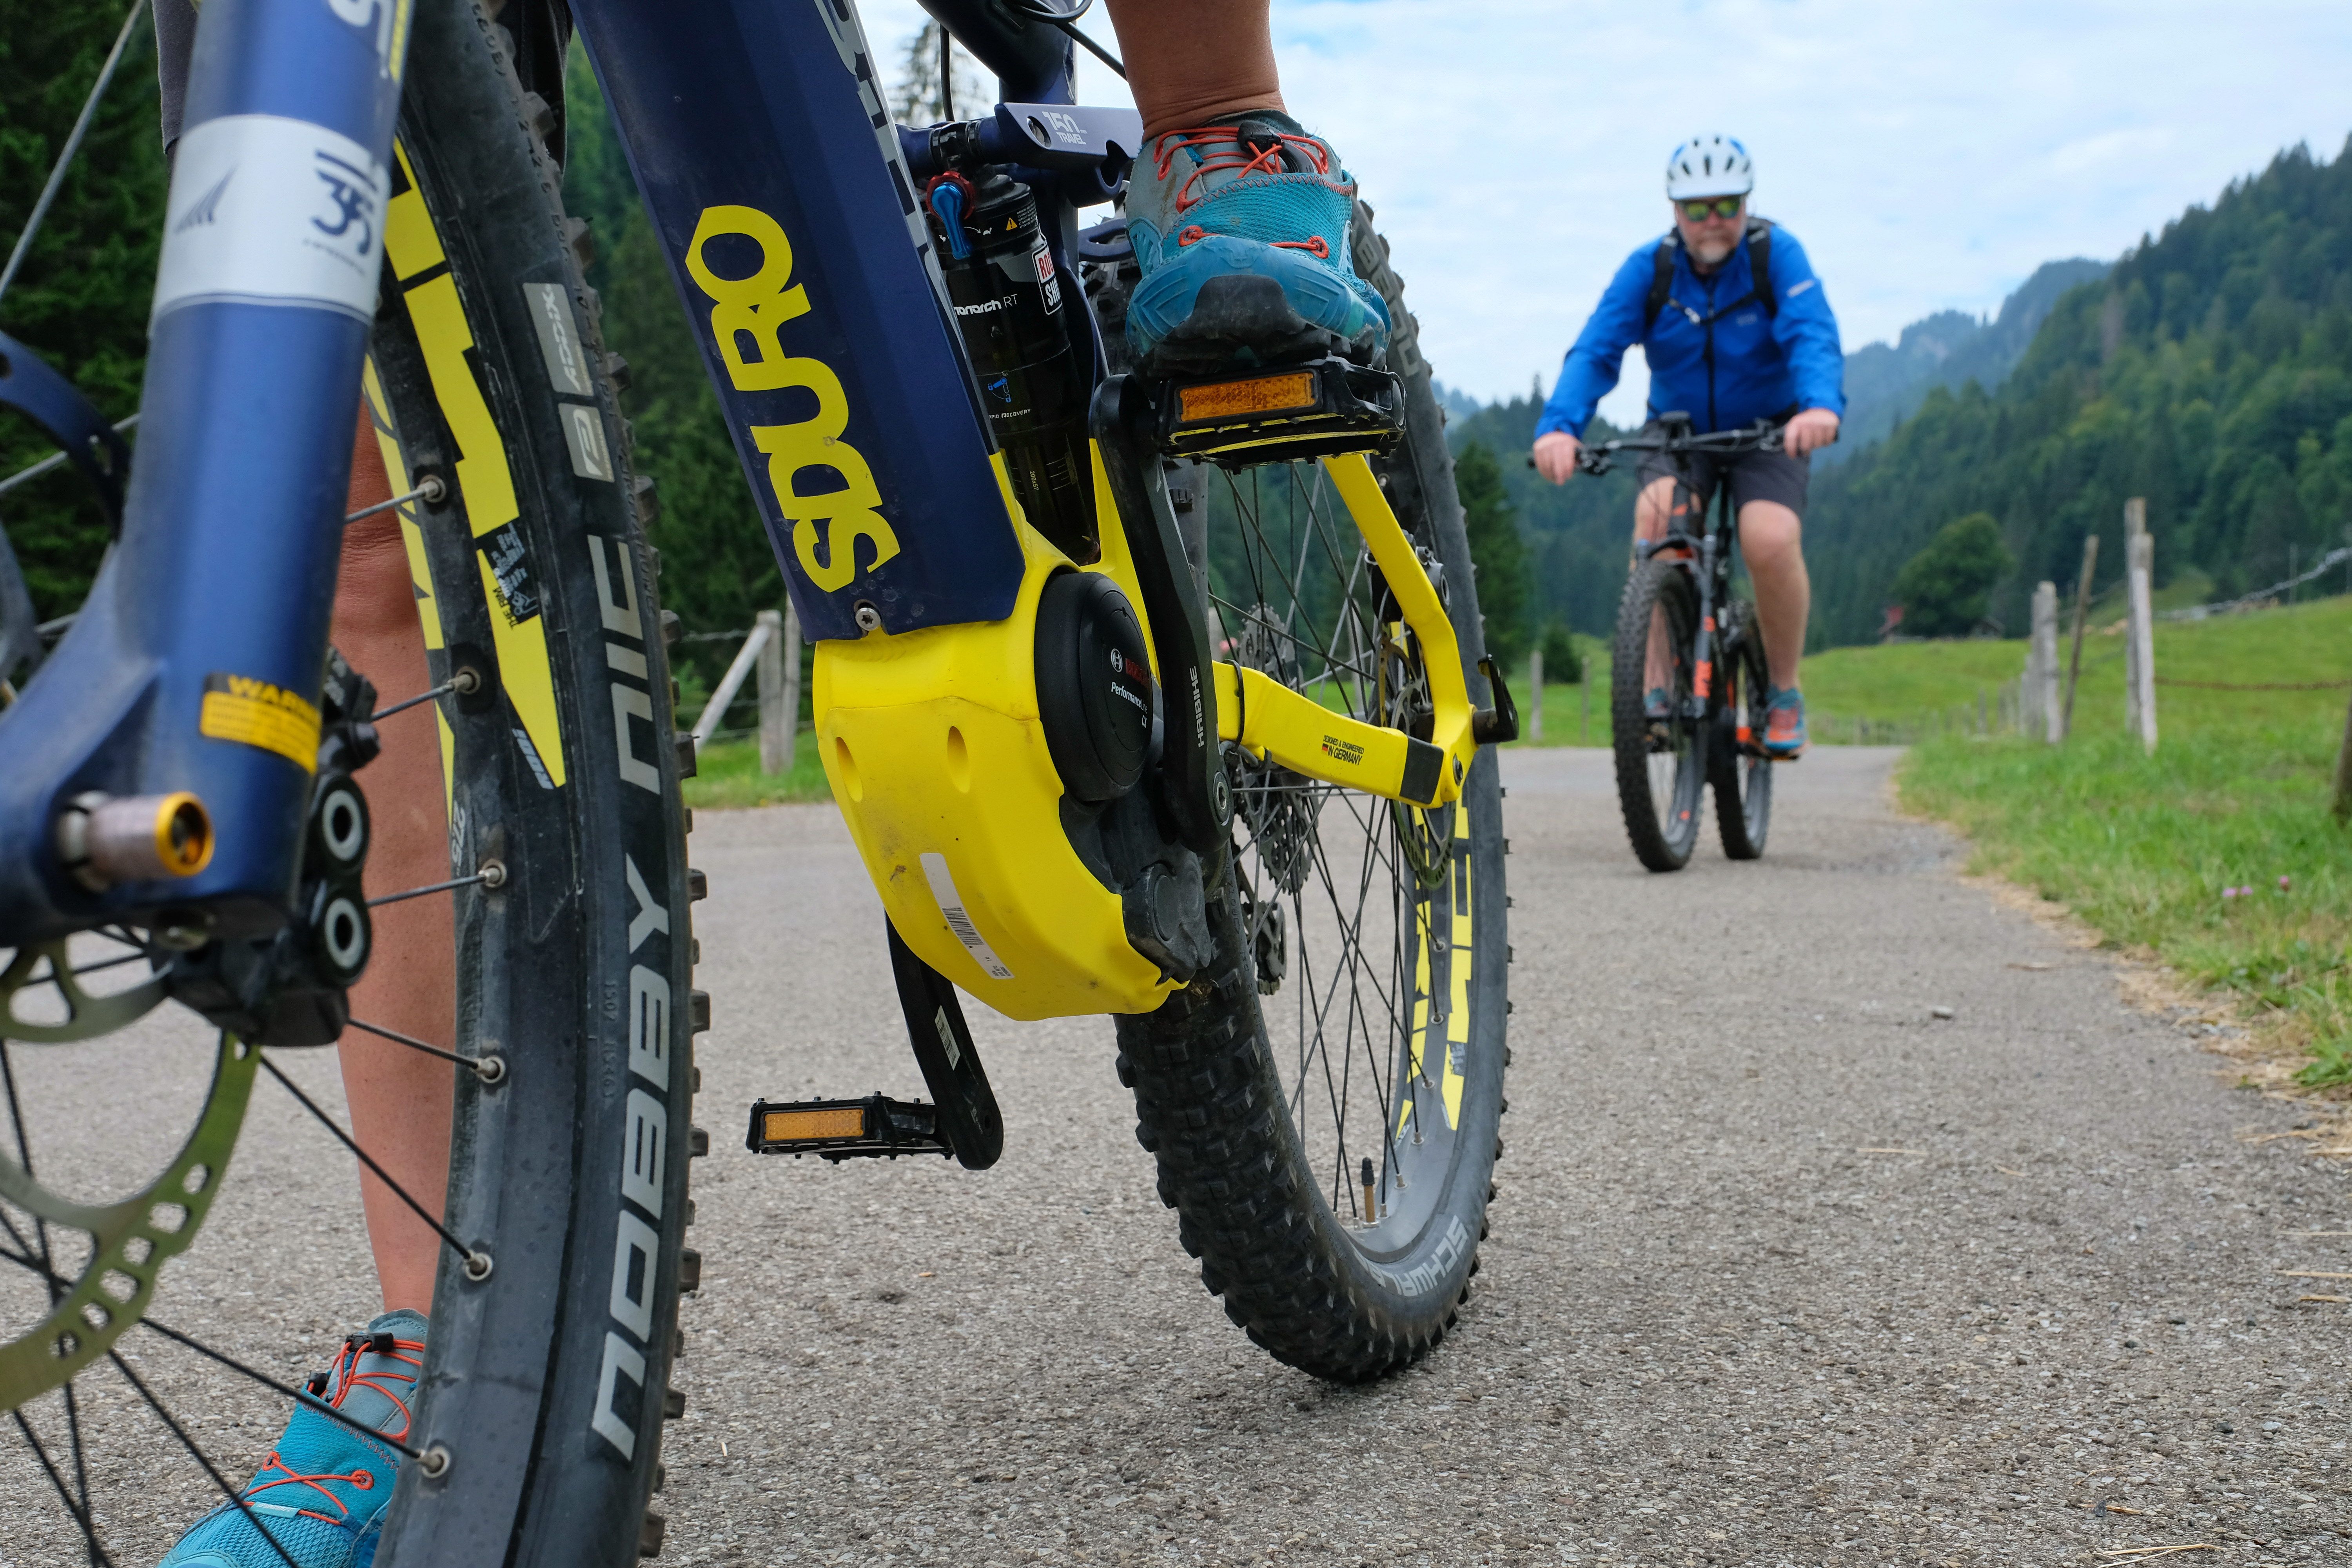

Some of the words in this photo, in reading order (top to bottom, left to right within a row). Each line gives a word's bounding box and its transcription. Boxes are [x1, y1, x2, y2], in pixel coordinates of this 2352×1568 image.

[1056, 132, 1086, 145] TRAVEL
[1003, 294, 1017, 308] RT
[686, 205, 901, 592] SDURO
[1001, 408, 1031, 418] RECOVERY
[1029, 470, 1039, 490] 200x57
[587, 534, 661, 795] NIC
[1111, 681, 1141, 708] Performance
[1189, 666, 1204, 748] HAIBIKE
[1142, 715, 1147, 729] CX
[1323, 734, 1339, 746] DESIGNED
[1342, 741, 1365, 755] ENGINEERED
[1327, 745, 1334, 757] IN
[1334, 747, 1363, 766] GERMANY
[591, 852, 669, 1461] NOBBY
[1352, 1214, 1469, 1298] SCHWALBE
